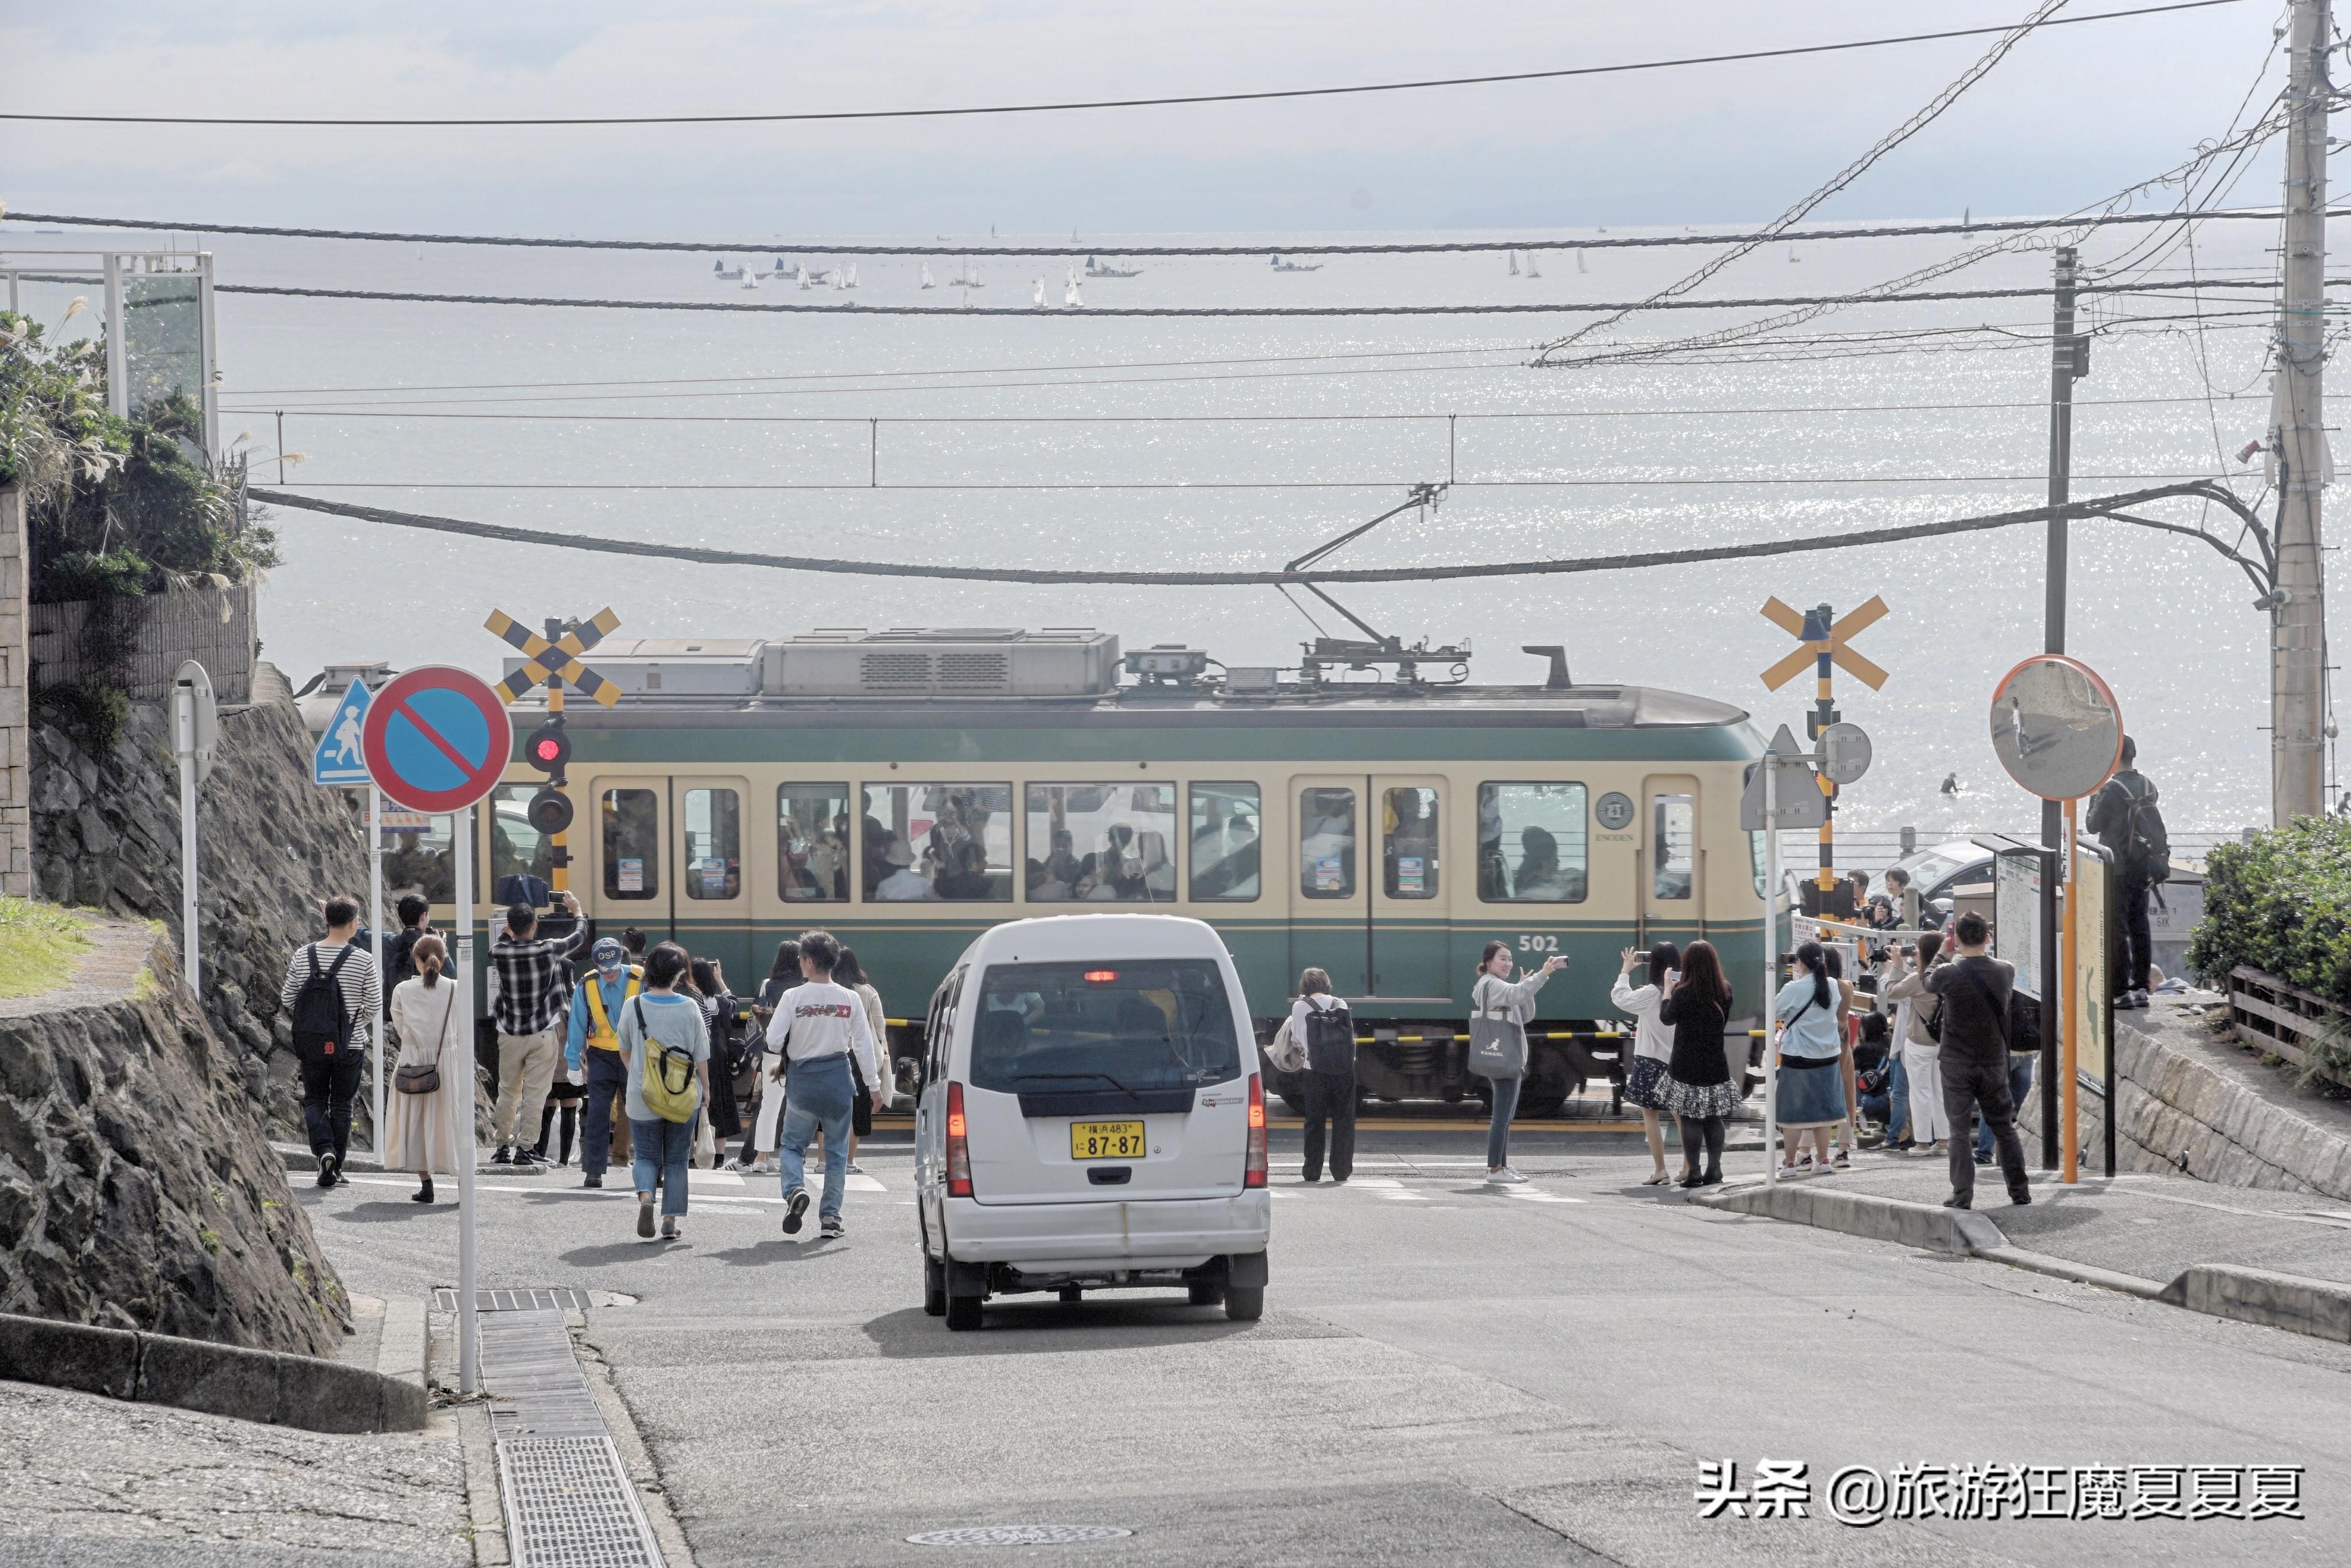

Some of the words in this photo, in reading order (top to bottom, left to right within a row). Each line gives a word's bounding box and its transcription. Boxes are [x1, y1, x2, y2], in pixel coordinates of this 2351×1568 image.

[1518, 935, 1558, 951] 502
[598, 950, 616, 960] OSP
[1088, 1136, 1140, 1155] 87-87
